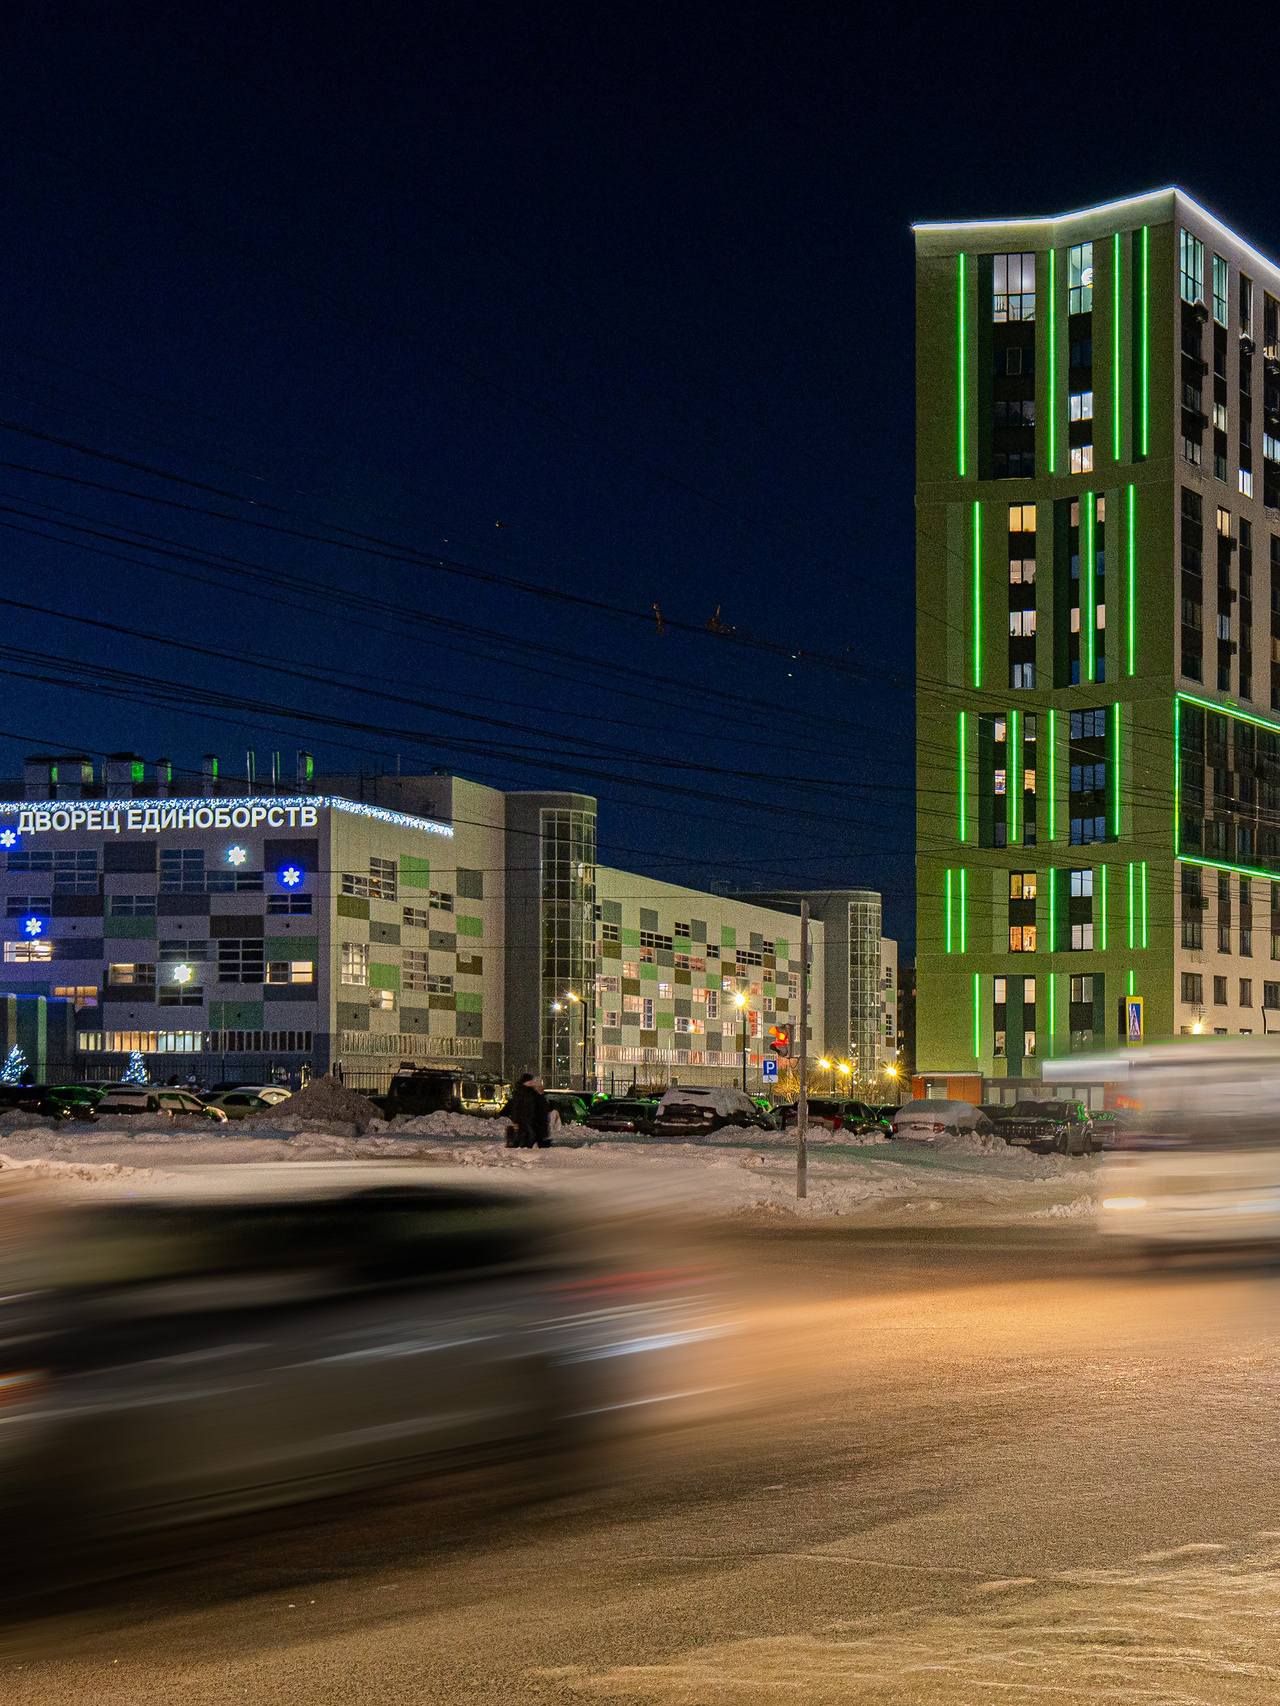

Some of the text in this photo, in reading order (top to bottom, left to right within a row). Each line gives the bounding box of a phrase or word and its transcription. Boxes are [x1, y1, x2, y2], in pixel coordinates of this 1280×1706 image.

[17, 807, 318, 835] ДВОРЕЦ ЕДИНОБОРСТВ
[766, 1061, 775, 1074] P
